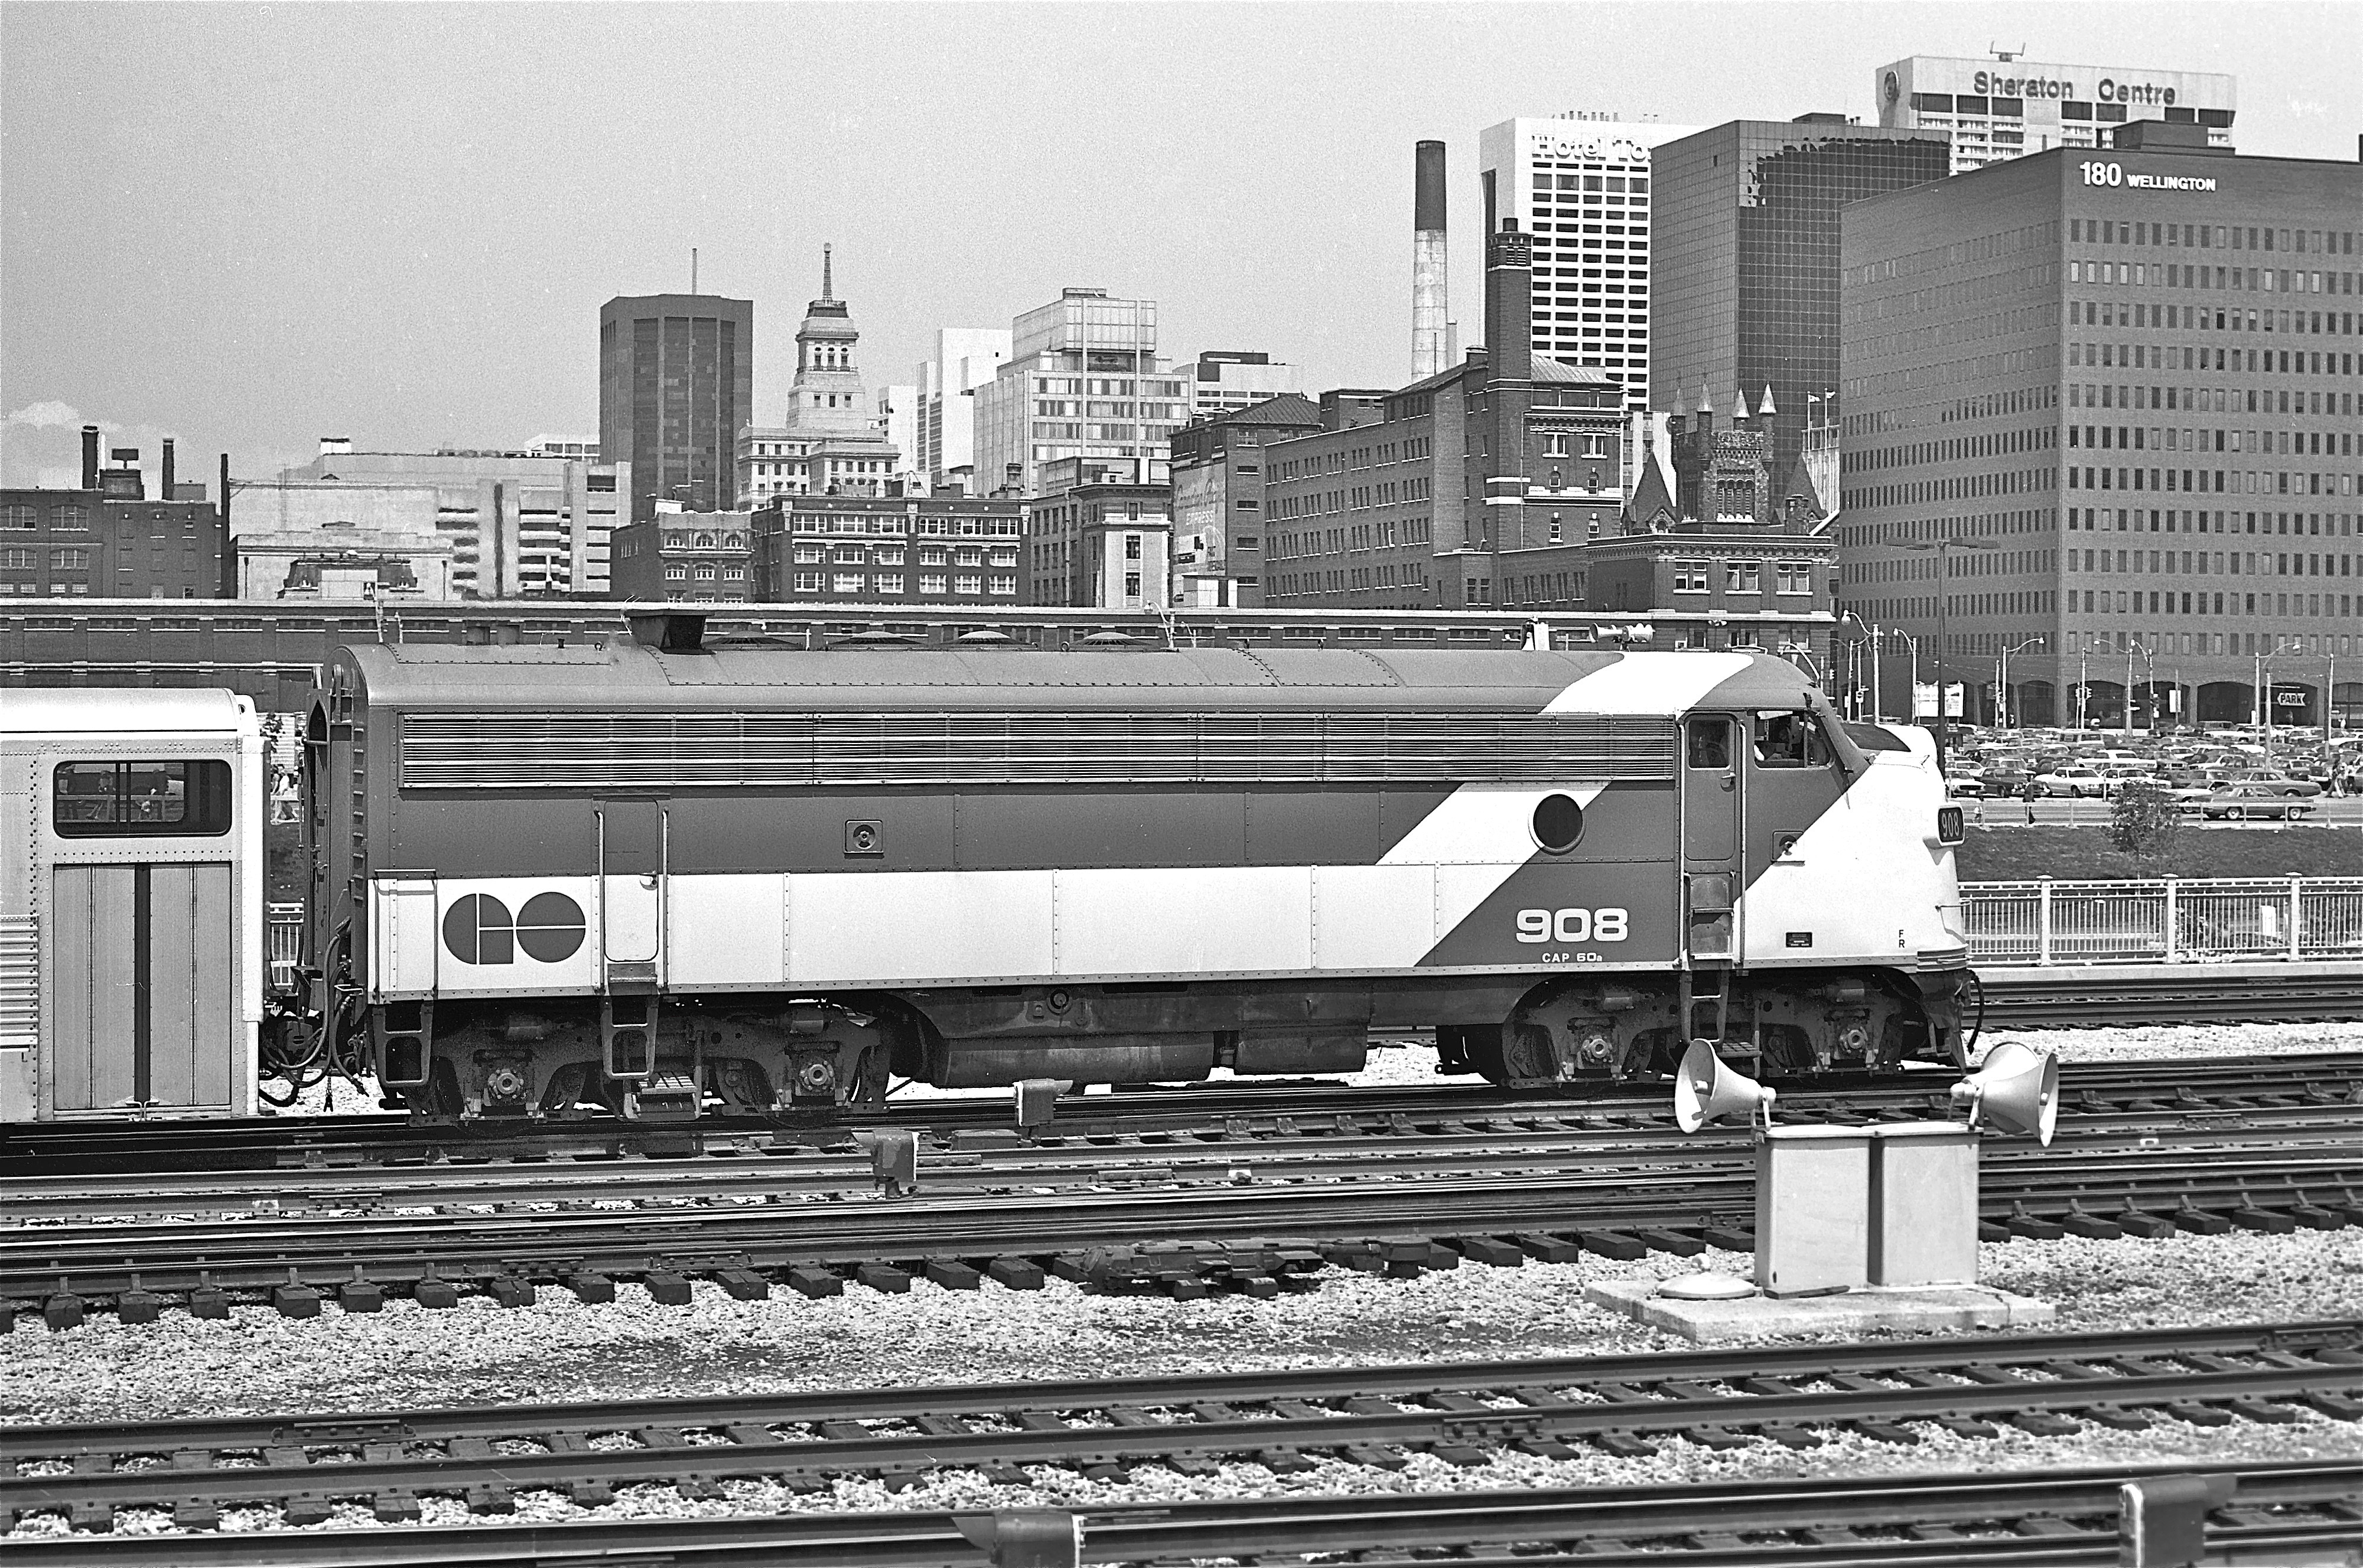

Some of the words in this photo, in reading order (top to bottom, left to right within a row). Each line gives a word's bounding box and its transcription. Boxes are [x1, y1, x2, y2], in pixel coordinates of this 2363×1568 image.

[1974, 70, 2074, 99] Sheraton
[2098, 78, 2176, 105] Centre
[1531, 133, 1607, 161] Hotel
[2079, 161, 2122, 187] 180
[2127, 174, 2216, 192] WELLINGTON
[2280, 695, 2302, 703] PARK
[1942, 812, 1960, 837] 908
[1516, 908, 1629, 943] 908
[1899, 930, 1904, 938] F
[1899, 939, 1905, 948] R
[1542, 953, 1570, 963] CAP
